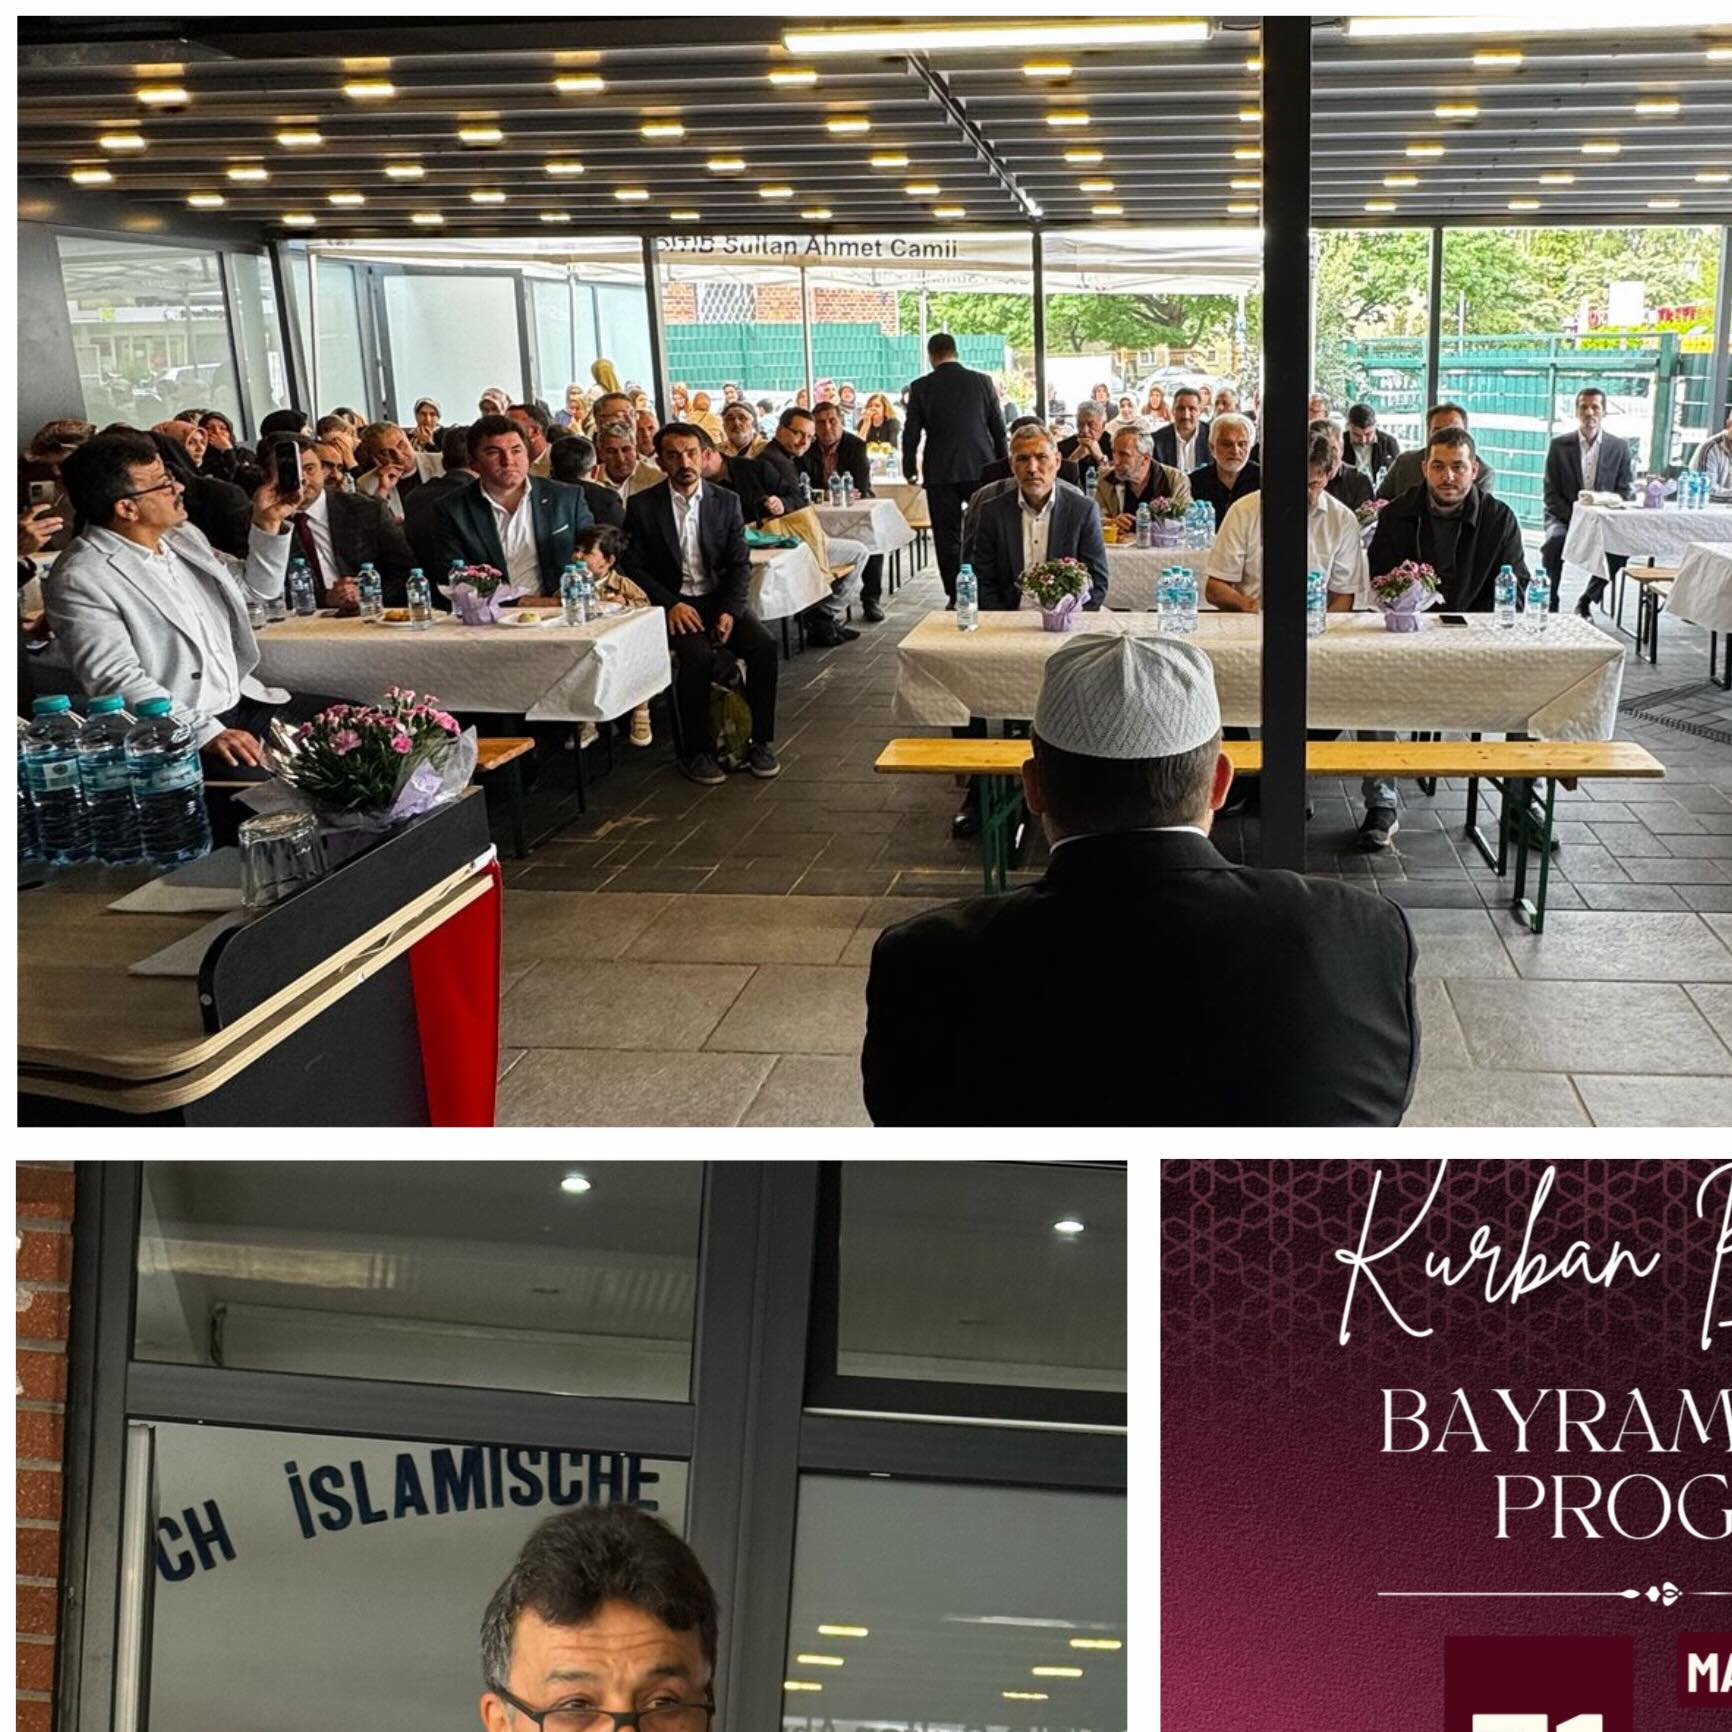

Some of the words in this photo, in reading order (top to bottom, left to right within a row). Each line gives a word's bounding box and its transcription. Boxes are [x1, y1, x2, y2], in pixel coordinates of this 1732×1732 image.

[722, 235, 798, 255] Sultan
[804, 234, 882, 257] Ahmet
[890, 238, 957, 258] Camii
[1335, 1161, 1660, 1345] Kurban
